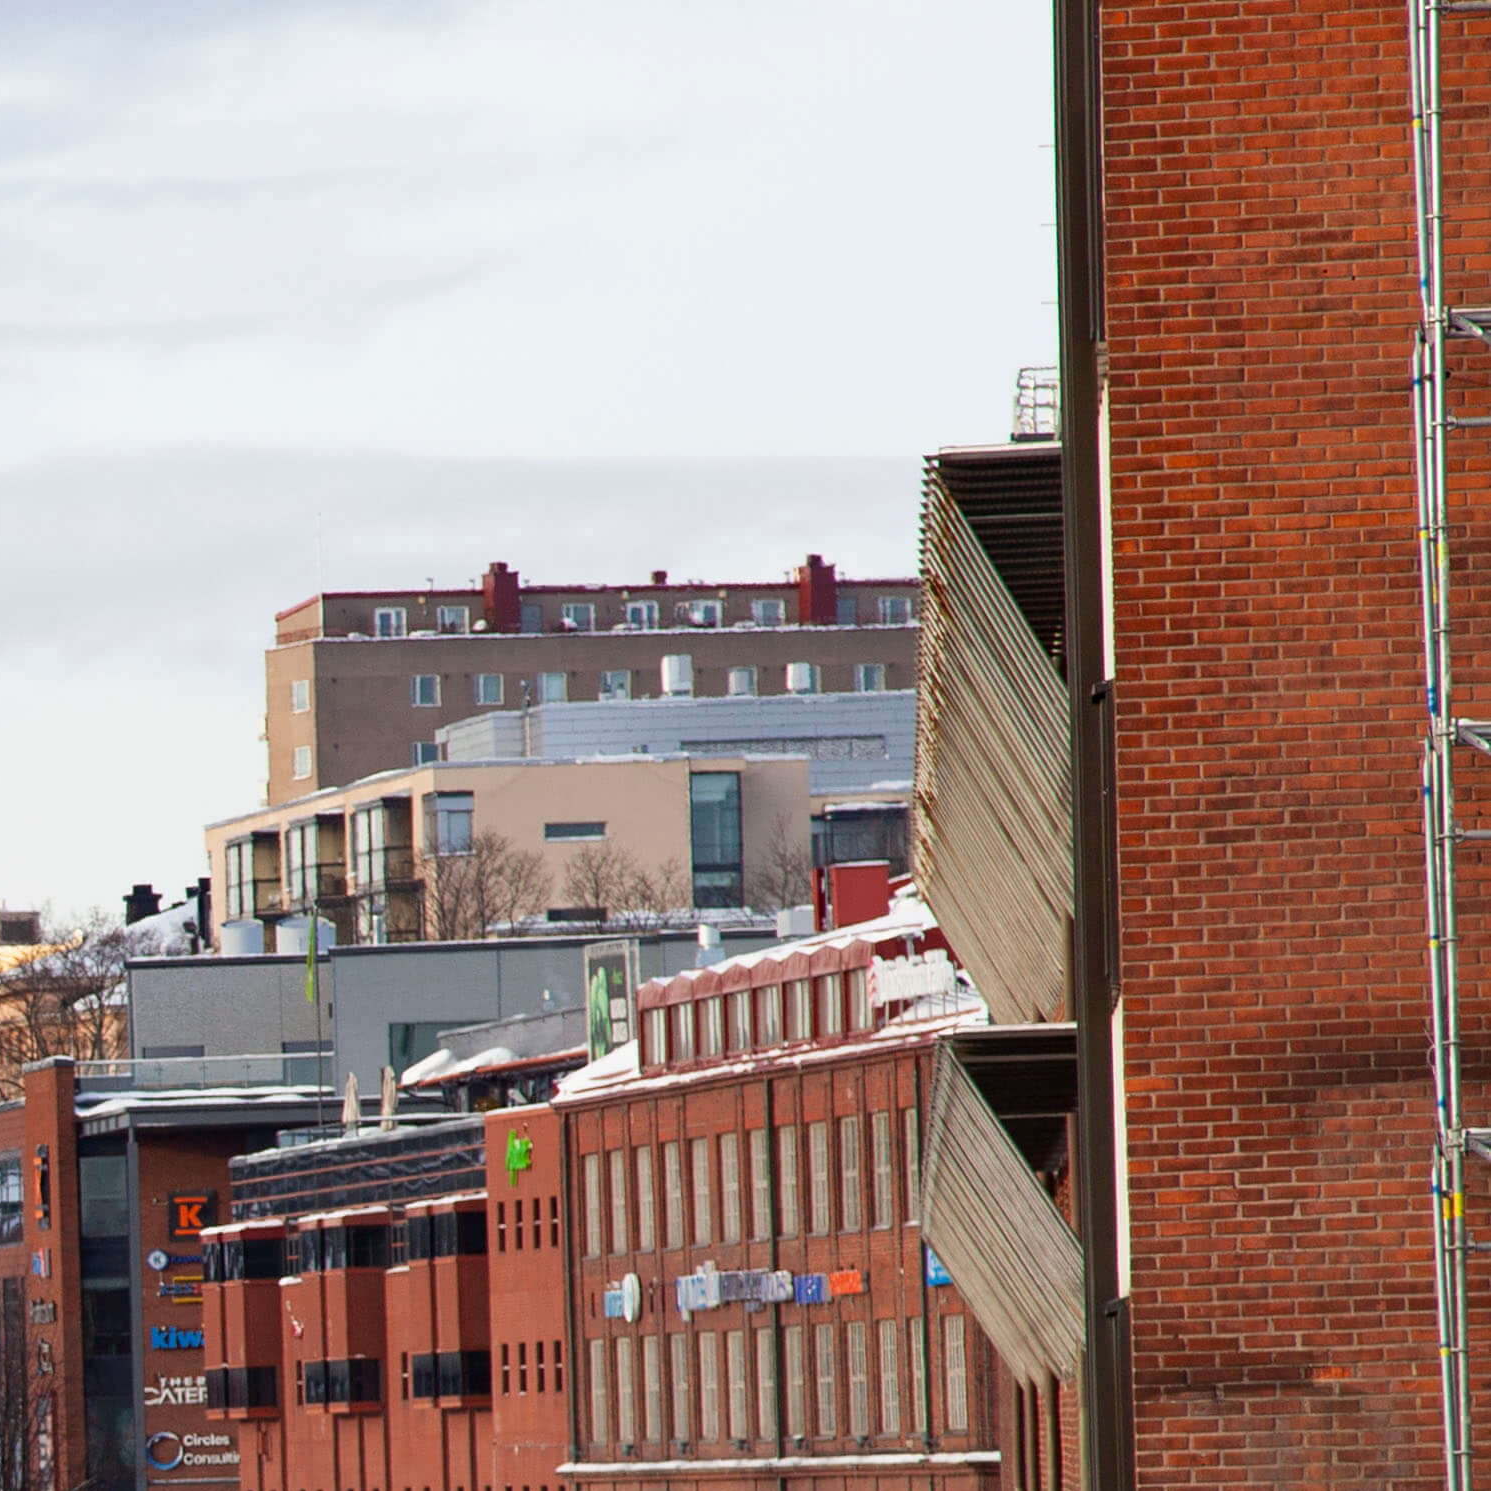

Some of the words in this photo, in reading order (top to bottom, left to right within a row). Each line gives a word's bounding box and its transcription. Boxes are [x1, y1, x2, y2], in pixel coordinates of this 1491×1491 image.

[179, 1204, 202, 1228] K
[150, 1326, 205, 1349] kiw
[182, 1433, 230, 1447] Circles
